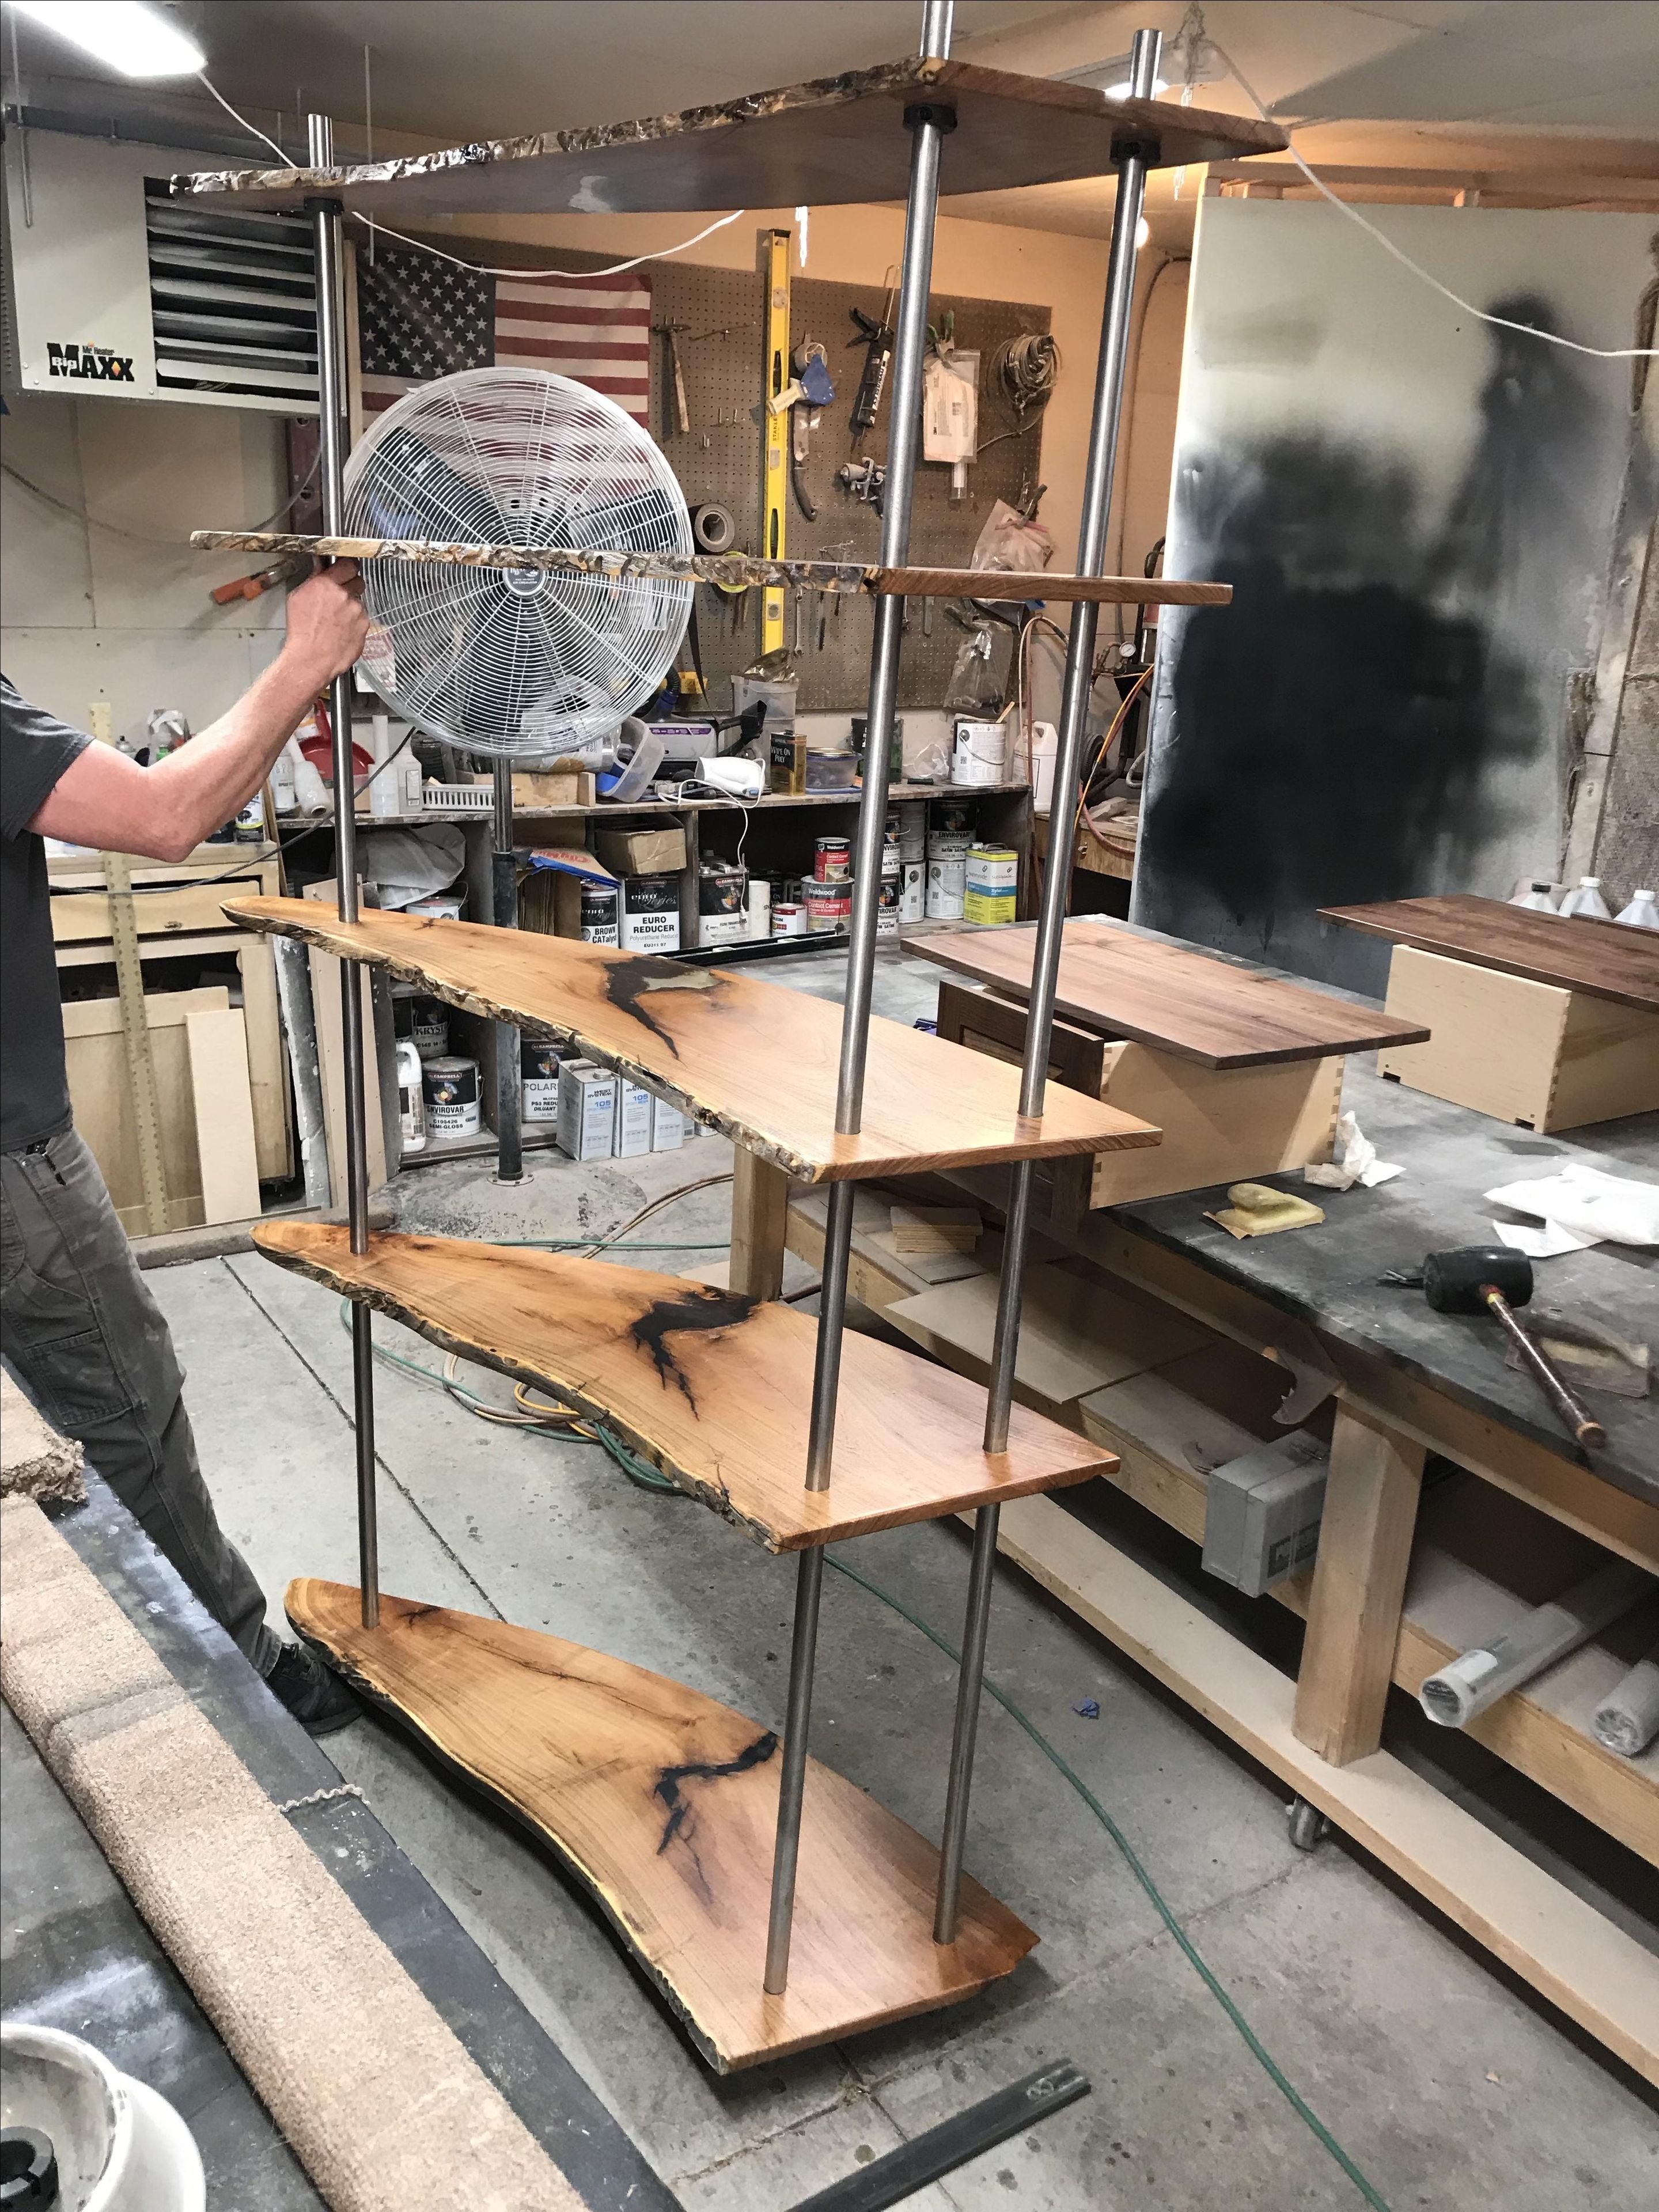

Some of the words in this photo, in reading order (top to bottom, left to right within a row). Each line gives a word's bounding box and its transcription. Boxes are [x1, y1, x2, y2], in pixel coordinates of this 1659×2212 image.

[47, 342, 135, 382] MAXX
[51, 357, 77, 369] Big
[775, 754, 786, 763] POLY
[808, 888, 835, 896] Weldwood
[642, 916, 666, 924] EURO
[595, 926, 615, 935] BROWN
[634, 925, 675, 933] REDUCER
[523, 1083, 559, 1091] POLAR
[427, 1105, 464, 1113] ENVIROVAR
